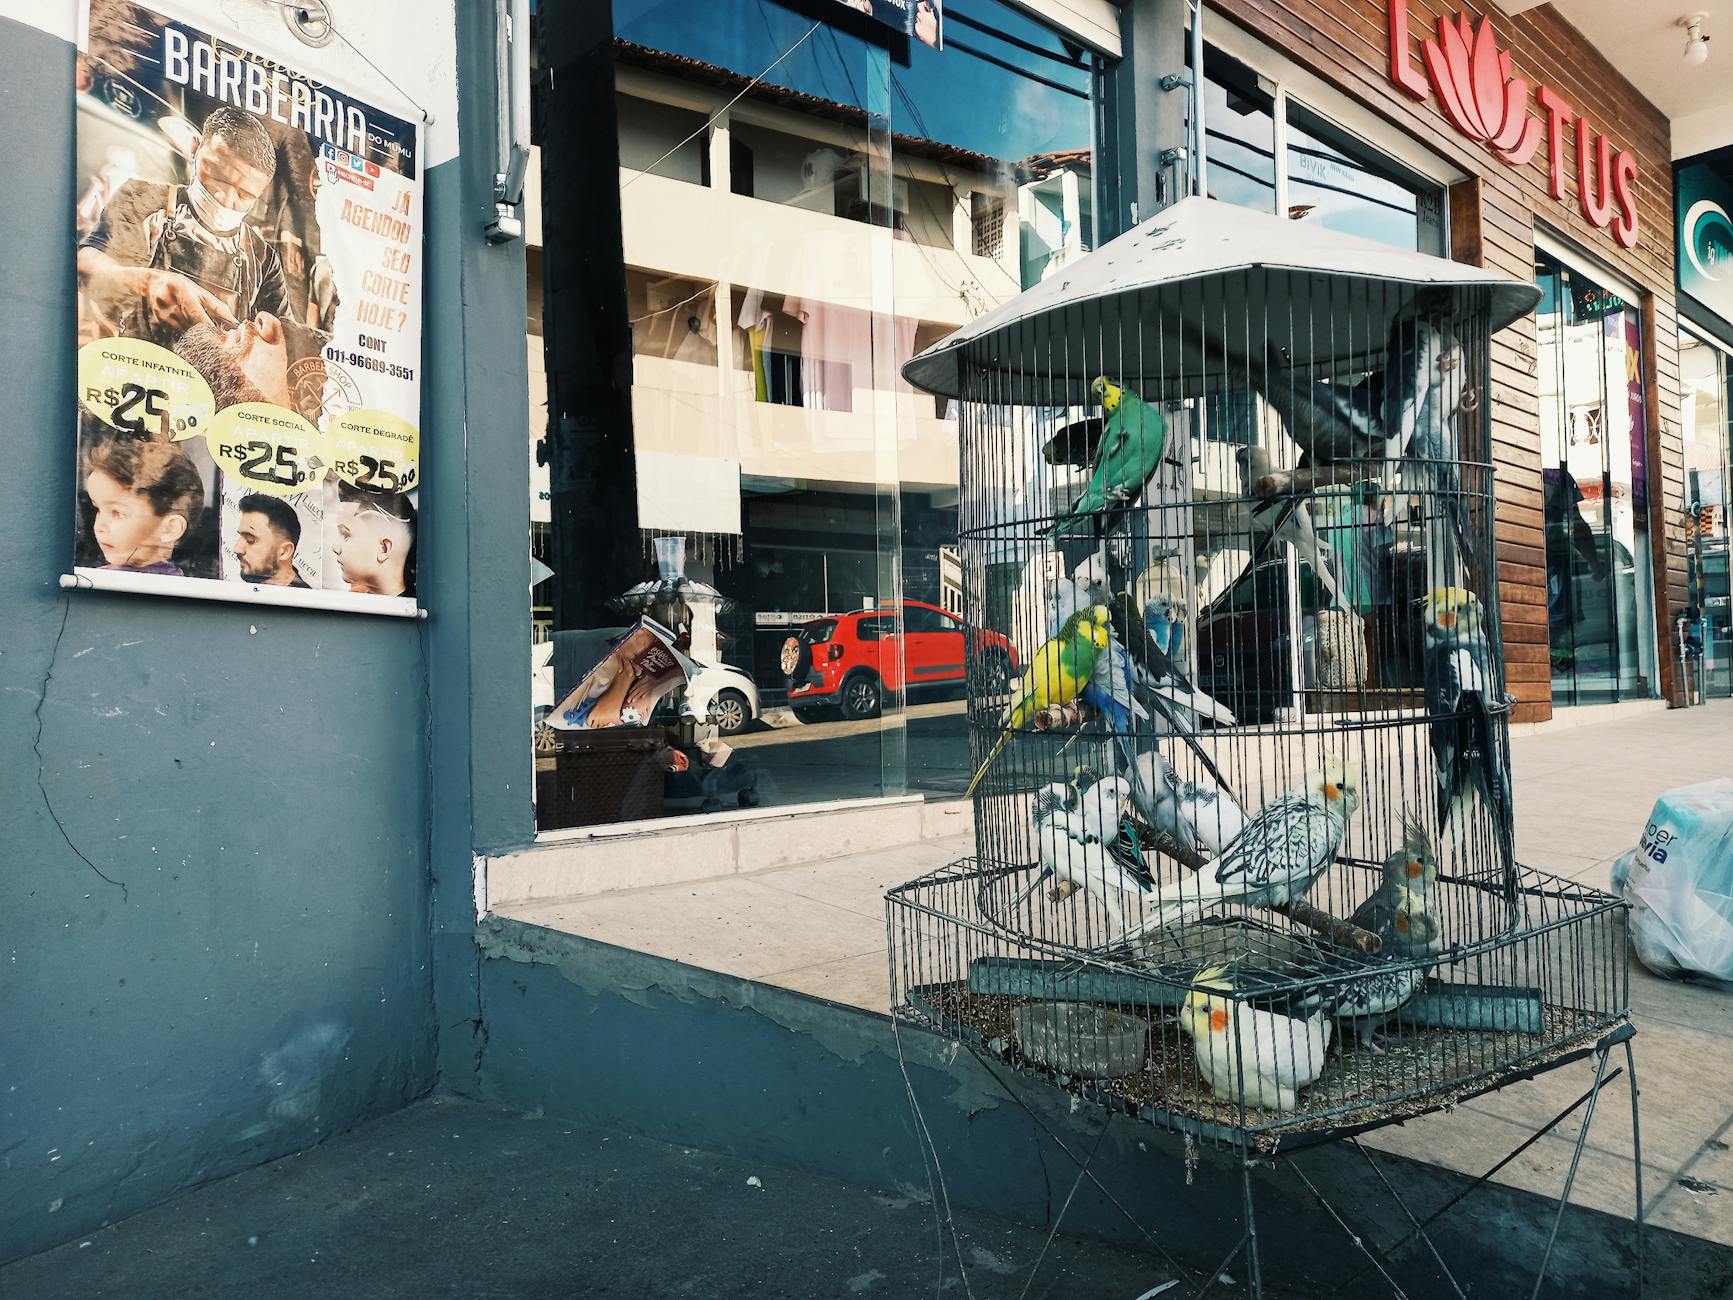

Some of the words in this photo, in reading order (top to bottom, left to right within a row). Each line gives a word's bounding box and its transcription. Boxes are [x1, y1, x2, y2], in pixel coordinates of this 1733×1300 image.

[164, 26, 366, 157] BARBEARIA
[368, 132, 382, 145] DO
[384, 139, 412, 158] MUMU
[392, 190, 411, 217] JÁ
[340, 198, 411, 245] AGENDOU
[382, 247, 411, 275] SEU
[362, 269, 411, 305] CORTE
[358, 333, 387, 353] CONT
[101, 351, 140, 366] CORTE
[141, 359, 197, 379] INFATNTIL
[326, 347, 414, 382] 011-96689-3551
[328, 366, 352, 389] SHOP
[237, 411, 271, 424] CORTE
[272, 418, 306, 432] SOCIAL
[340, 422, 372, 434] CORTE
